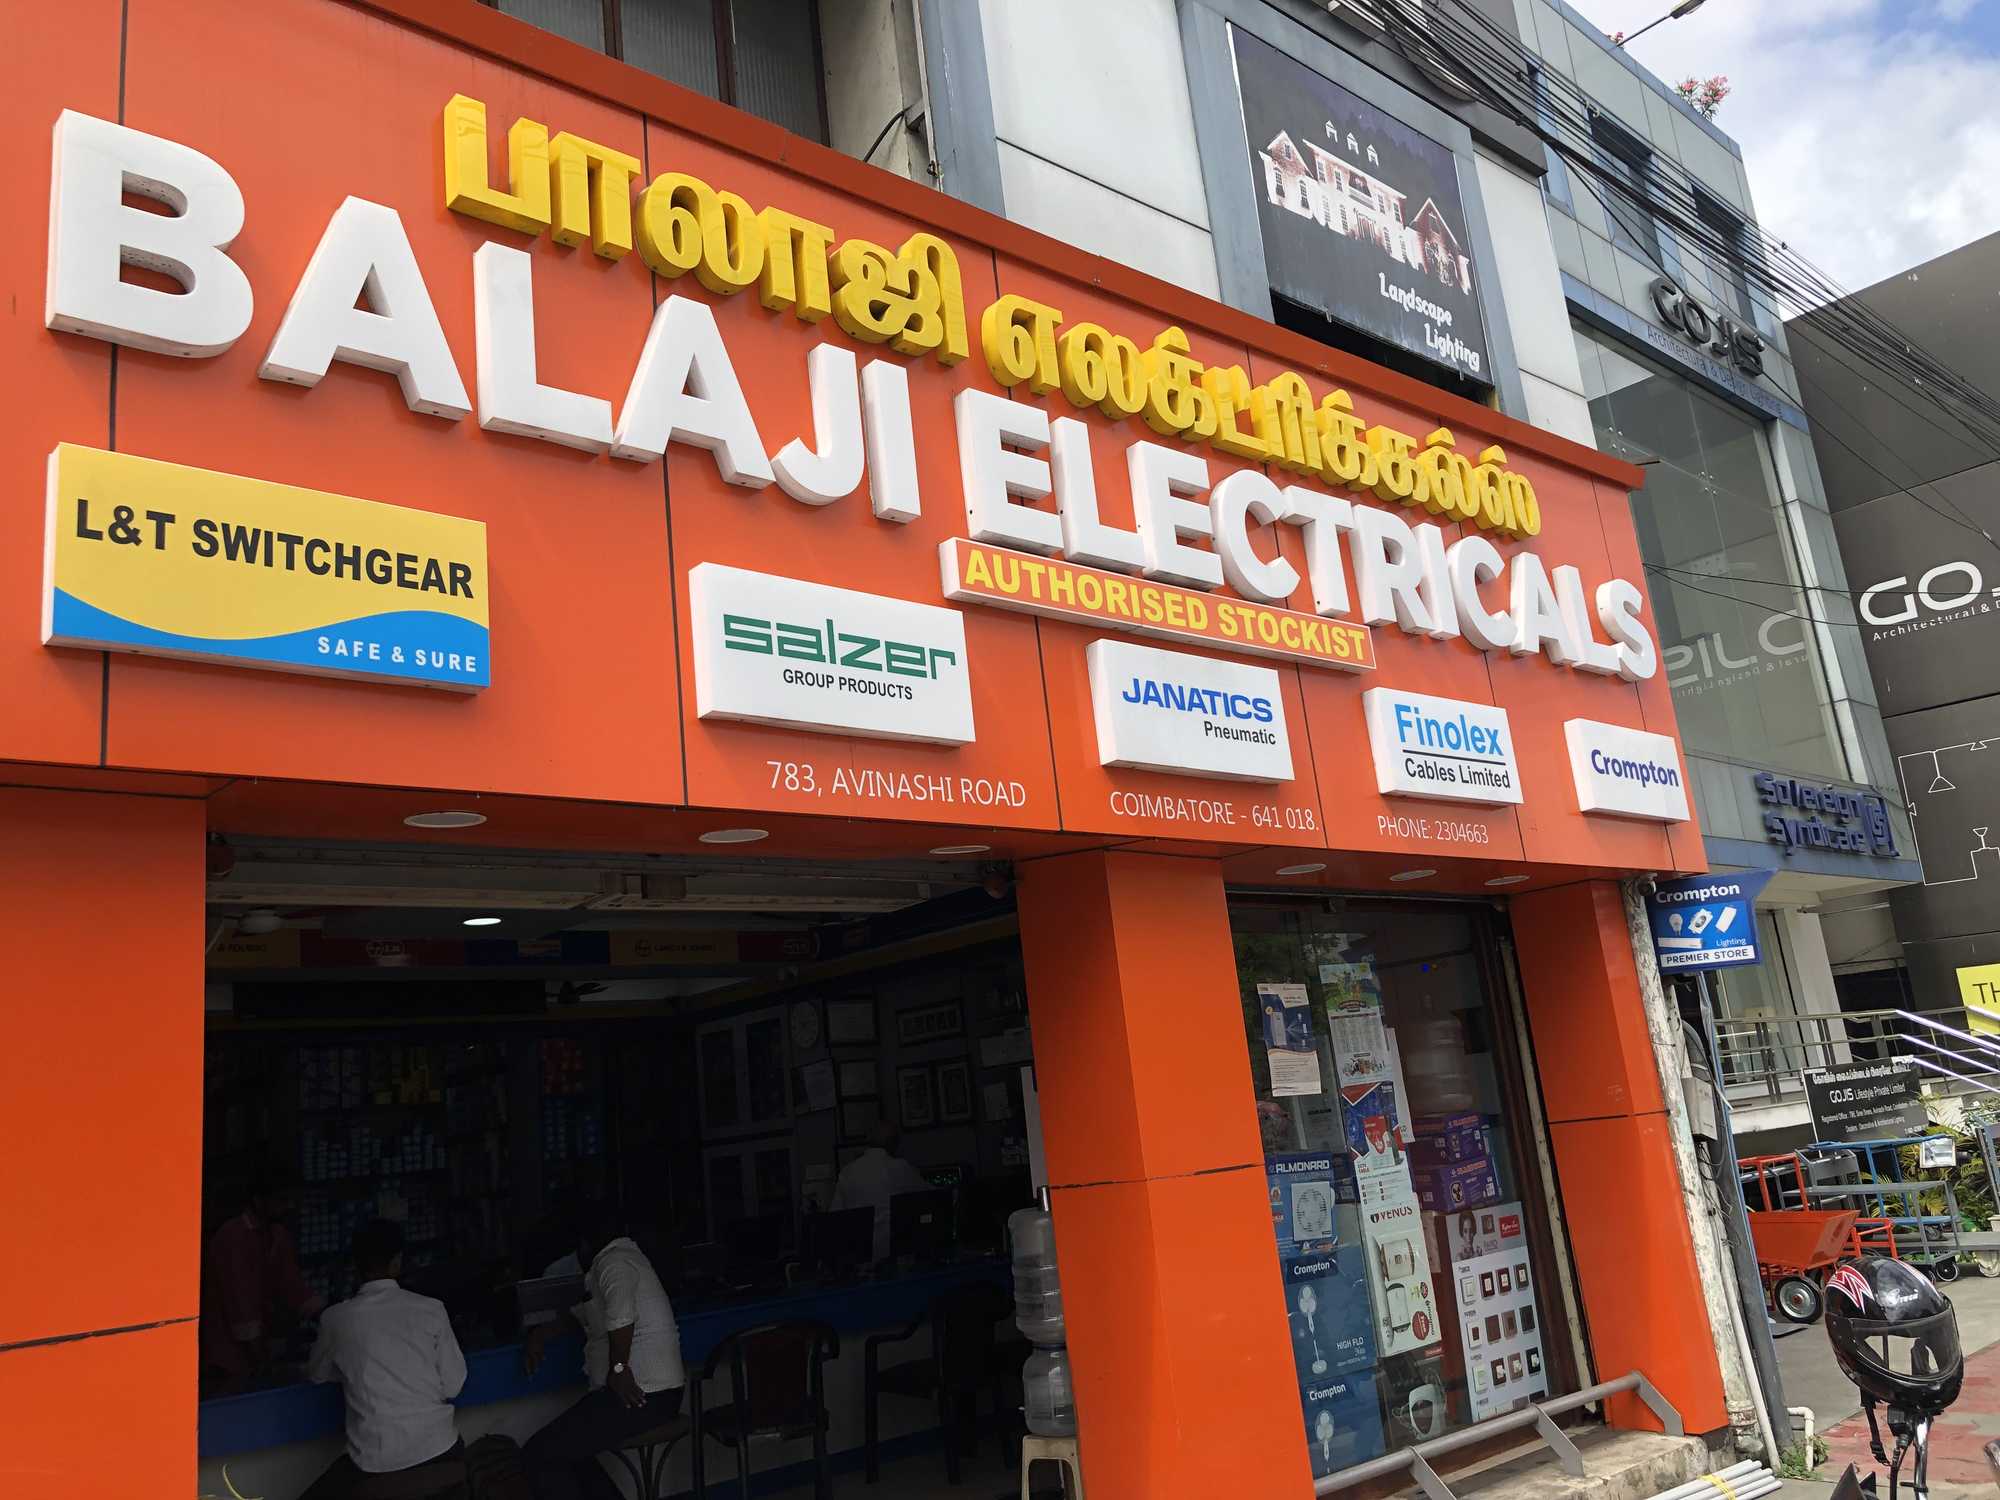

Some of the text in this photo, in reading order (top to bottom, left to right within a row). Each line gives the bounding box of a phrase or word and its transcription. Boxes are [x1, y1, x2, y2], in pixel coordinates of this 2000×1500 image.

[444, 93, 969, 367] பாலாஜி
[1379, 272, 1452, 326] Landscape
[1424, 323, 1480, 372] Lighting
[45, 108, 1657, 682] BALAJI ELECTRICALS
[75, 498, 474, 598] L&T SWITCHGEAR
[965, 550, 1366, 661] AUTHORISED STOCKIST
[1860, 561, 2000, 626] GO
[1873, 603, 1991, 641] Architectural &
[318, 636, 477, 673] SAFE & SURE
[723, 613, 956, 681] salzer
[783, 668, 913, 701] GROUP PRODUCTS
[1122, 678, 1273, 723] JANATICS
[1204, 720, 1277, 746] Pneumatic
[1394, 704, 1505, 757] Finolex
[766, 761, 1026, 807] 783, AVINASHI ROAD
[1405, 758, 1511, 789] Cables Limited
[1591, 749, 1680, 788] Crompton
[1109, 791, 1235, 826] COIMBATORE
[1252, 804, 1281, 827] 641
[1286, 807, 1319, 831] 018.
[1378, 815, 1489, 844] PHONE: 2304663
[1656, 884, 1740, 903] Crompton
[1666, 949, 1749, 964] PREMIER STORE
[1716, 938, 1747, 948] Lighting
[1829, 1088, 1854, 1103] GOJIS
[1276, 1160, 1330, 1173] ALMONARD
[1381, 1206, 1412, 1220] VENUS
[1294, 1261, 1330, 1275] Crompton
[1309, 1383, 1346, 1400] Crompton
